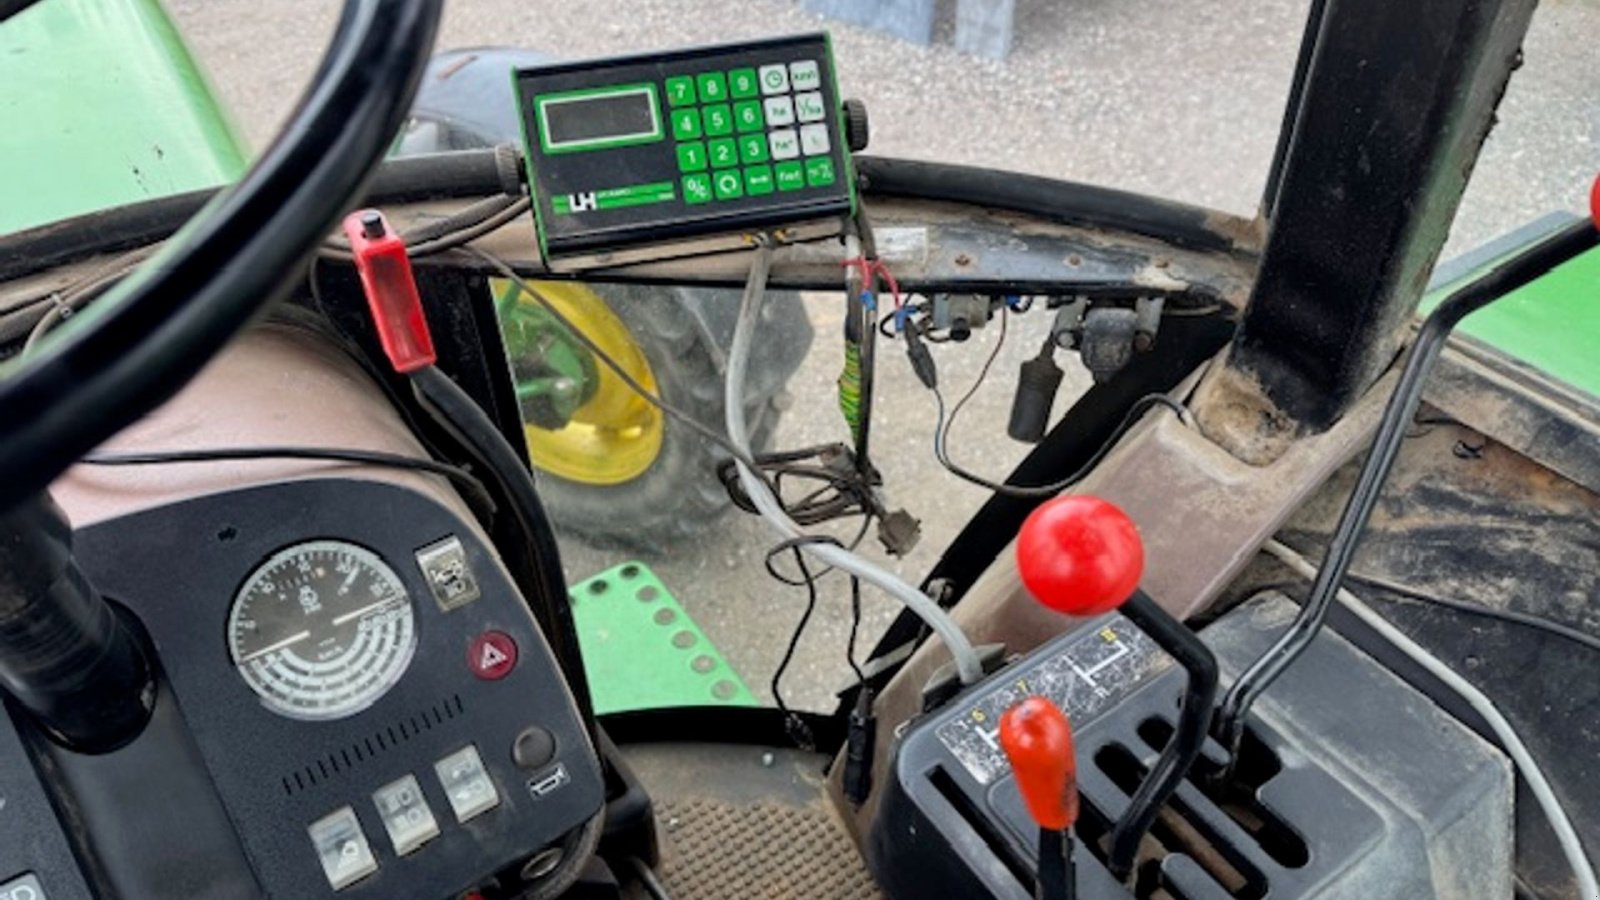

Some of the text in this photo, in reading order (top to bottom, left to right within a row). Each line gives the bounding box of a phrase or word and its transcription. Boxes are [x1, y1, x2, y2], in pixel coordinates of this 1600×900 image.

[675, 84, 686, 99] 7
[706, 80, 718, 96] 8
[737, 76, 750, 92] 9
[680, 113, 692, 132] 4
[712, 112, 724, 127] 5
[742, 108, 754, 123] 6
[717, 145, 729, 161] 2
[748, 141, 759, 156] 3
[687, 149, 697, 164] 1
[568, 191, 597, 213] LH
